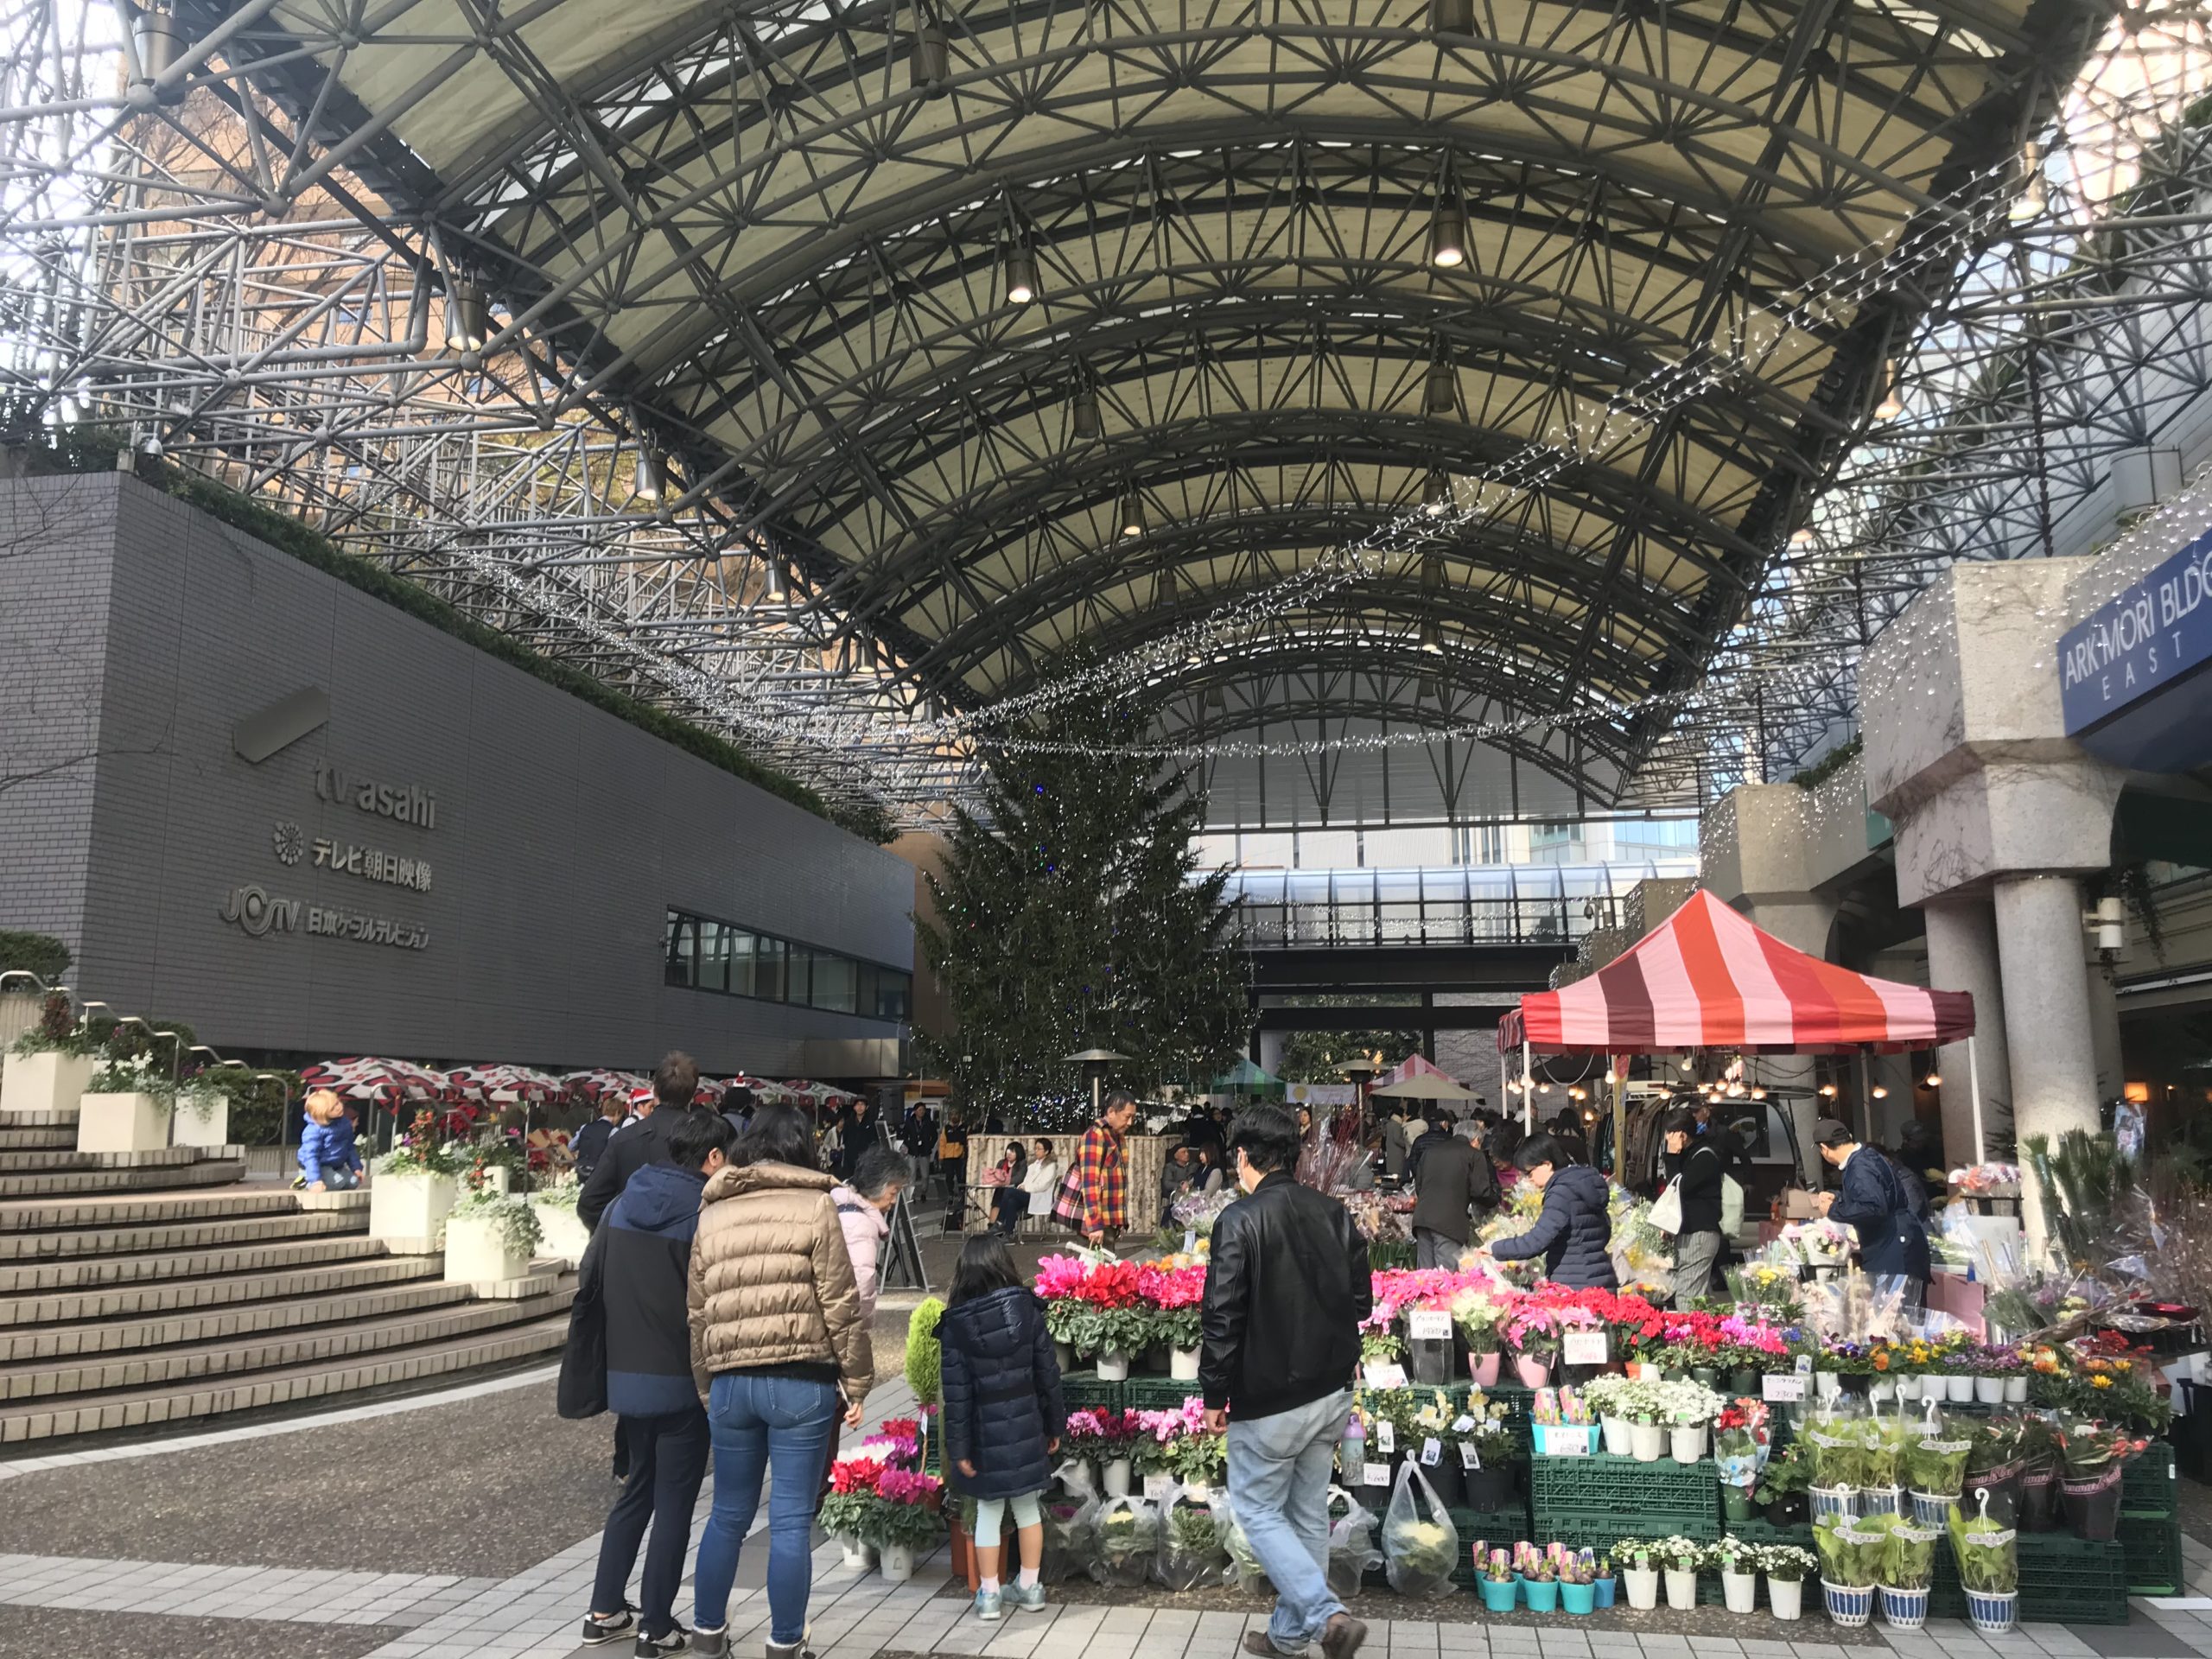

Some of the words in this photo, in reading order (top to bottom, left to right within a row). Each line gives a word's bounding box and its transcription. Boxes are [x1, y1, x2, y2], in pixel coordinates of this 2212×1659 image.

[2066, 633, 2100, 690] ARK
[2101, 593, 2155, 666] MORI
[2102, 631, 2182, 702] EAST
[357, 779, 436, 830] asahi
[311, 836, 433, 893] テレビ朝日映像
